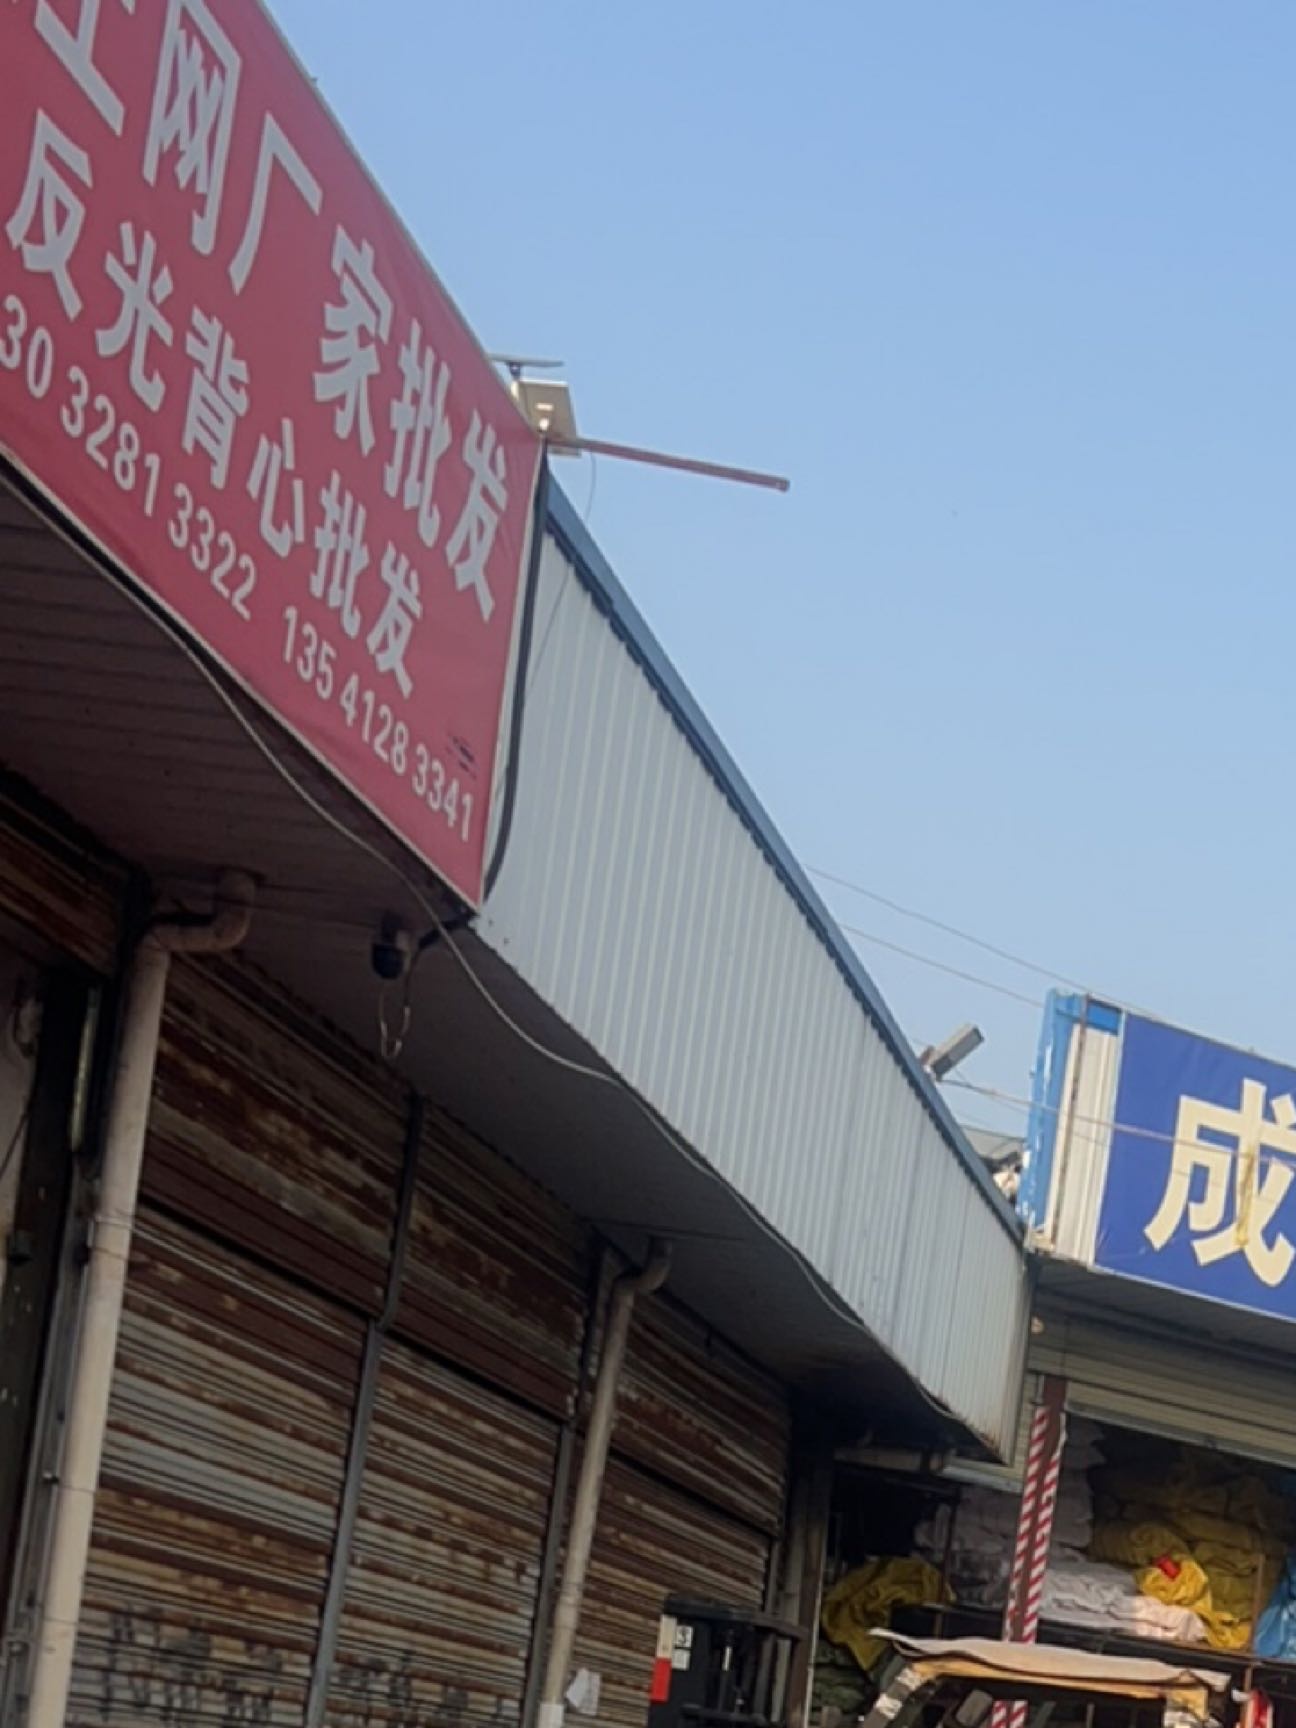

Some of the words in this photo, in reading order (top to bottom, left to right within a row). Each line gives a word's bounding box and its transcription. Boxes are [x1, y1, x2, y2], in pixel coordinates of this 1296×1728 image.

[6, 108, 423, 699] 反光背心批发
[60, 365, 160, 517] 3281
[168, 483, 256, 621] 3322
[283, 605, 337, 700] 135
[340, 674, 409, 775] 4128
[412, 744, 474, 842] 3341
